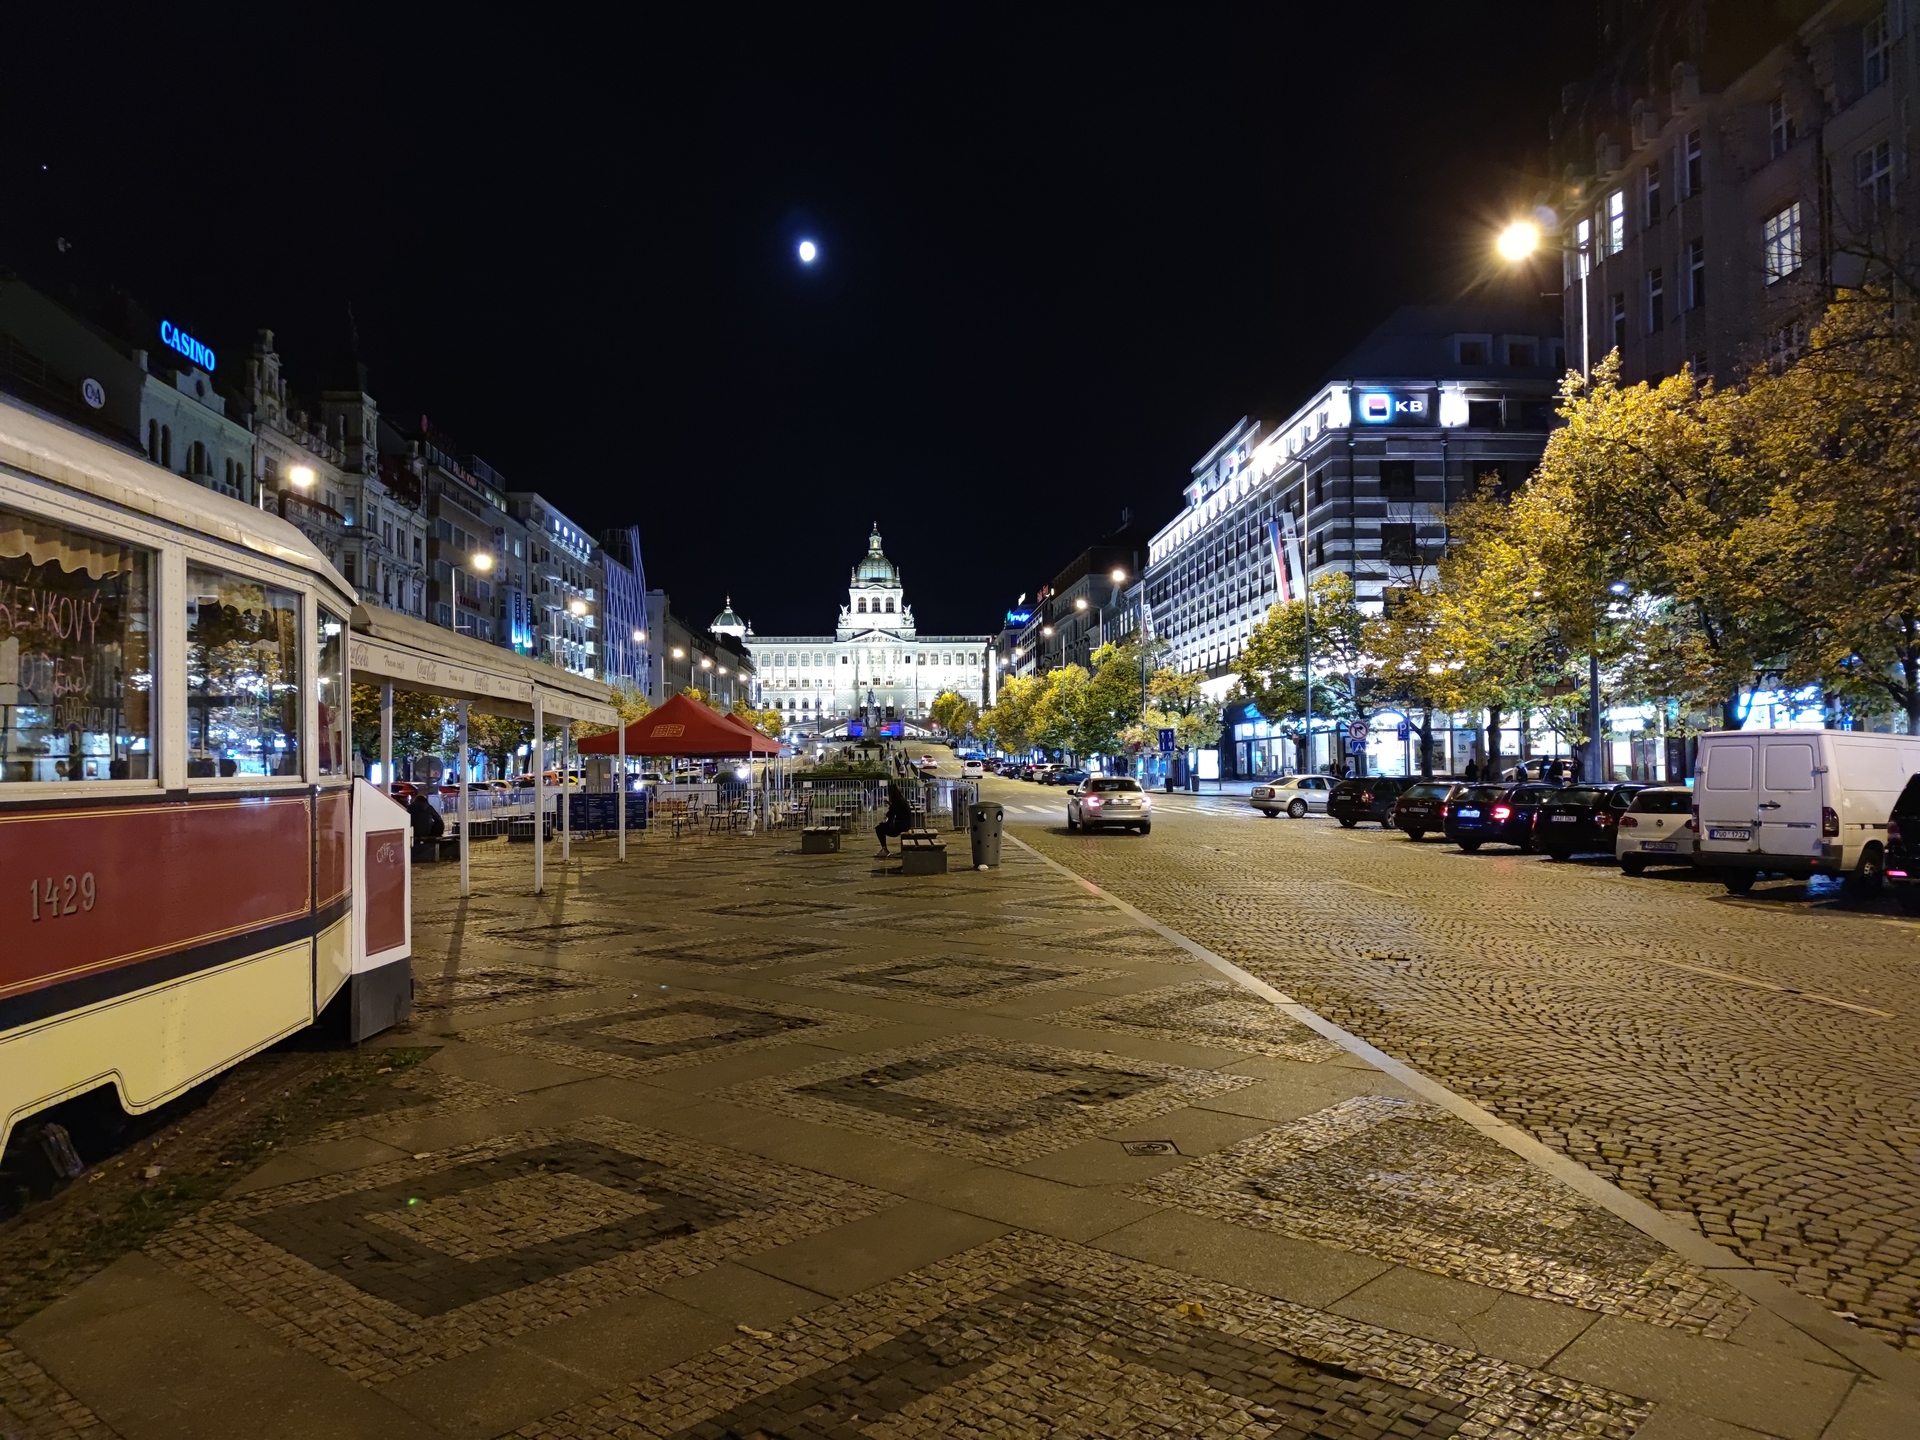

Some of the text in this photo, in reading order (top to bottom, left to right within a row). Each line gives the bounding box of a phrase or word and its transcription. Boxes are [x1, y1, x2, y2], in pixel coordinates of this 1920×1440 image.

[161, 320, 215, 371] CASINO
[85, 383, 102, 405] C&A
[1395, 400, 1423, 412] KB
[555, 519, 590, 554] HOTEL
[1399, 722, 1407, 735] P
[31, 871, 96, 921] 1429
